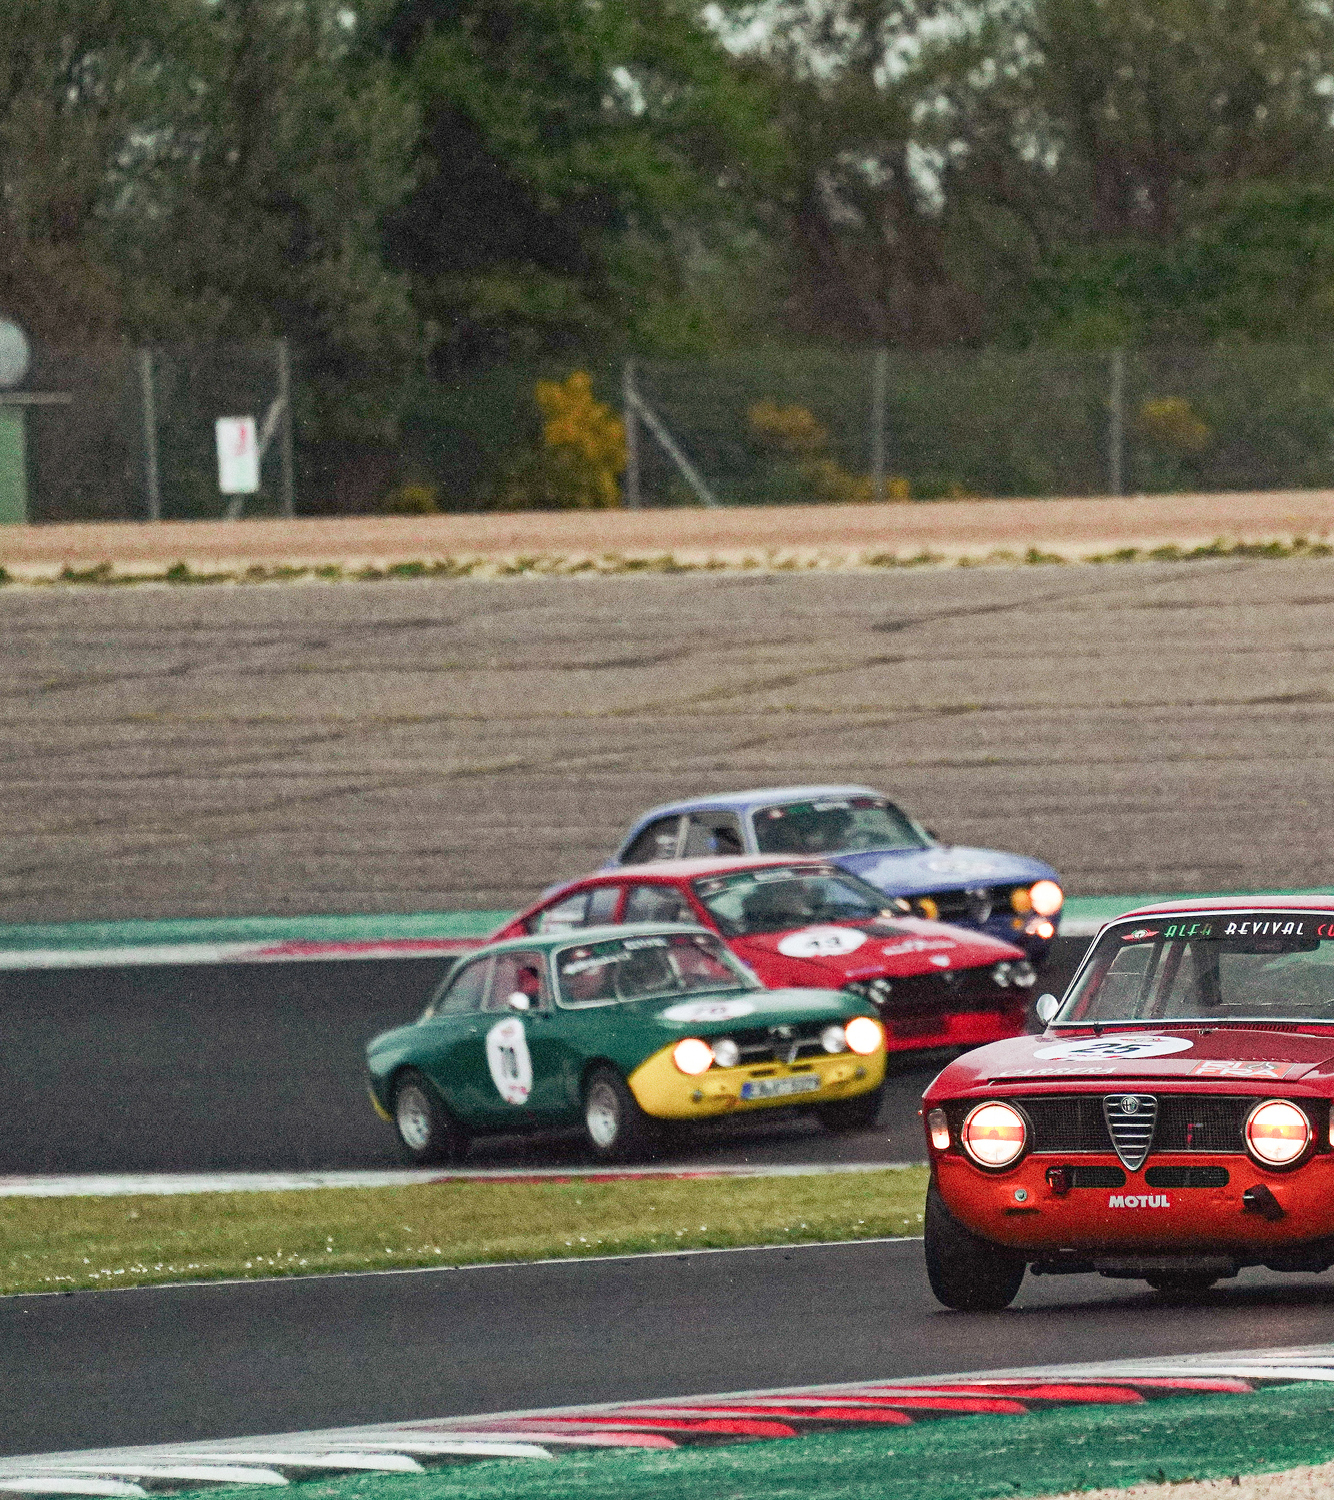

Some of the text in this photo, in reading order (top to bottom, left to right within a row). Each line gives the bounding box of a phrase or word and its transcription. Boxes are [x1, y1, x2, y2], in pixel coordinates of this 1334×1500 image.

[1164, 923, 1212, 938] ALFA
[1224, 921, 1304, 936] REVIVAL
[1070, 1043, 1153, 1054] 25
[1109, 1195, 1170, 1208] MOTUL
